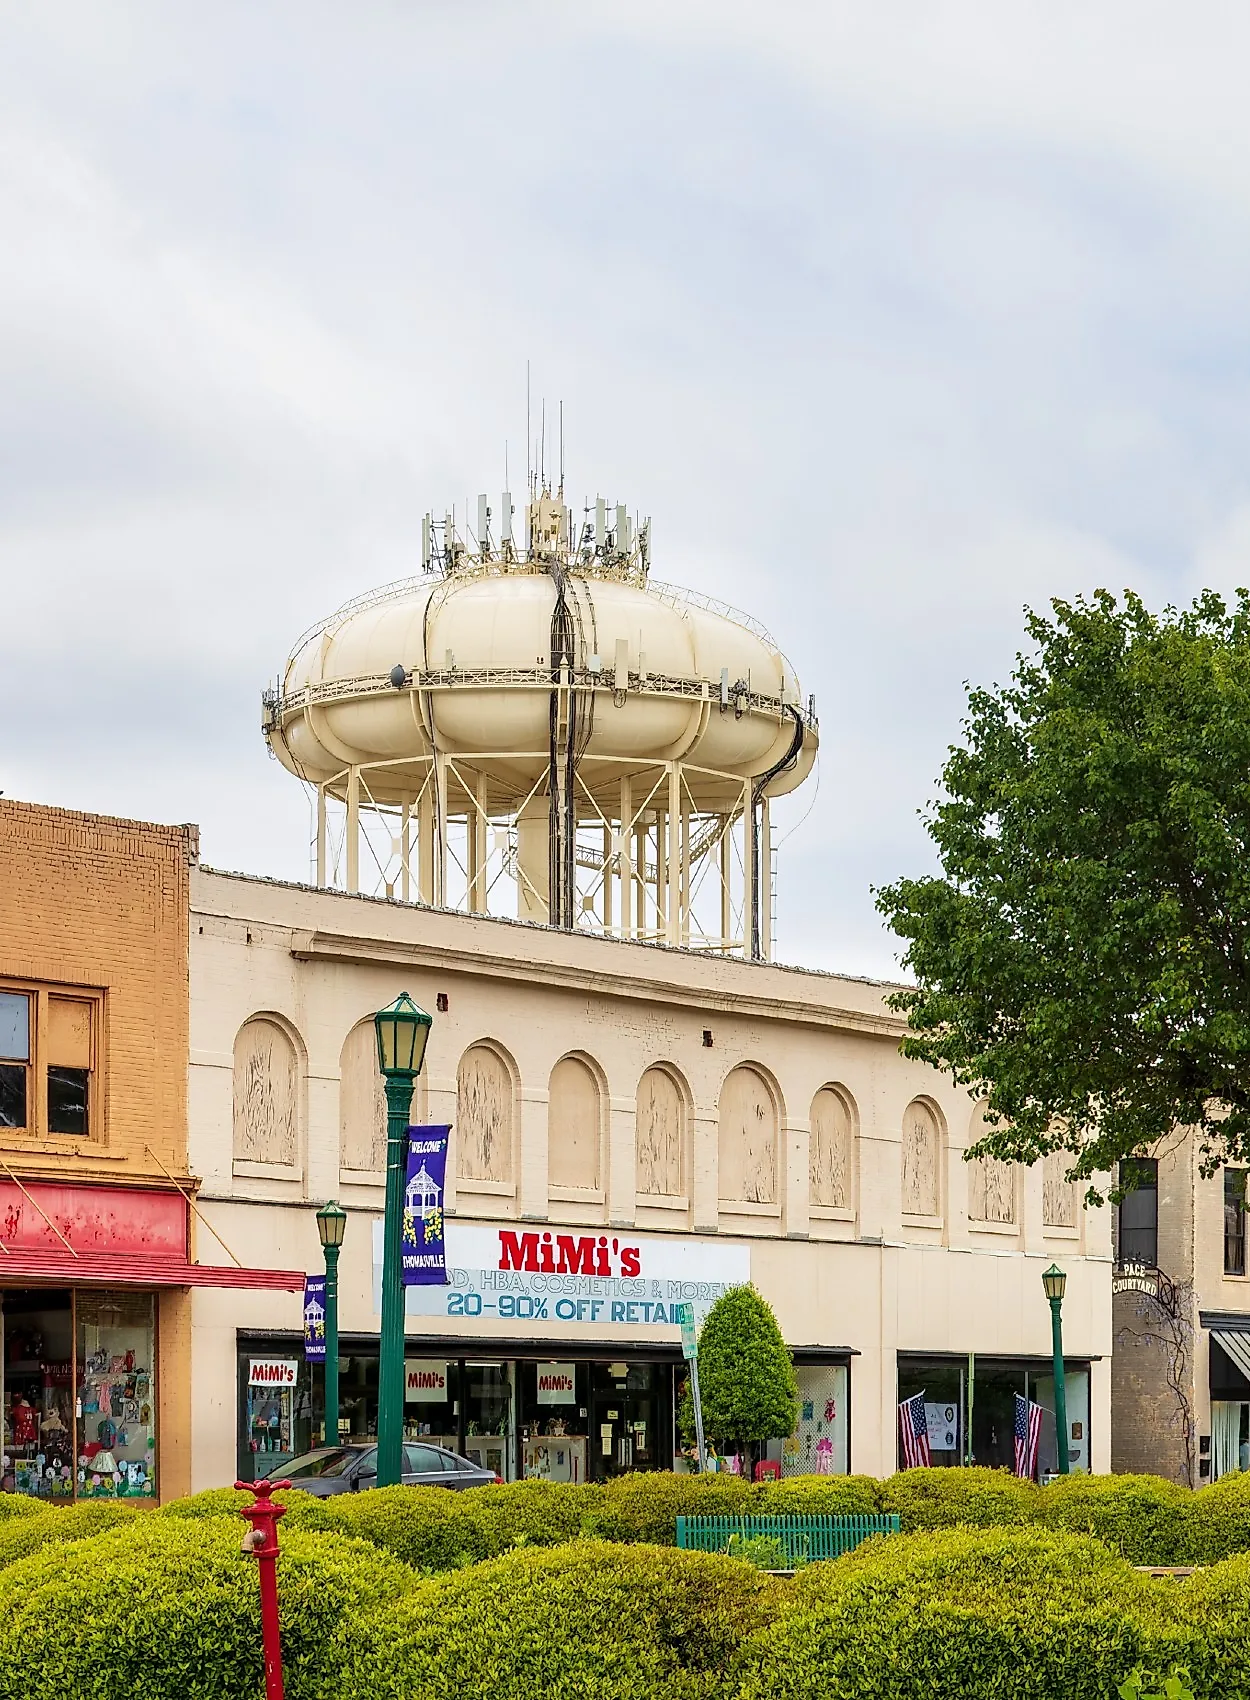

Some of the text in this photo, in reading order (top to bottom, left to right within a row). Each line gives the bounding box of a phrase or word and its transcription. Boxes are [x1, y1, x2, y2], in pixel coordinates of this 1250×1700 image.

[411, 1140, 442, 1153] WELCOME
[403, 1254, 445, 1269] THOMASVILLE
[499, 1230, 641, 1277] MiMi's
[1123, 1263, 1146, 1277] PACE
[652, 1279, 663, 1299] &
[1112, 1278, 1157, 1296] COURTYARD
[447, 1292, 548, 1319] 20-90%
[555, 1298, 604, 1321] OFF
[251, 1363, 294, 1382] MiMi's
[407, 1371, 445, 1389] MiMi's
[538, 1374, 573, 1391] MiMi's
